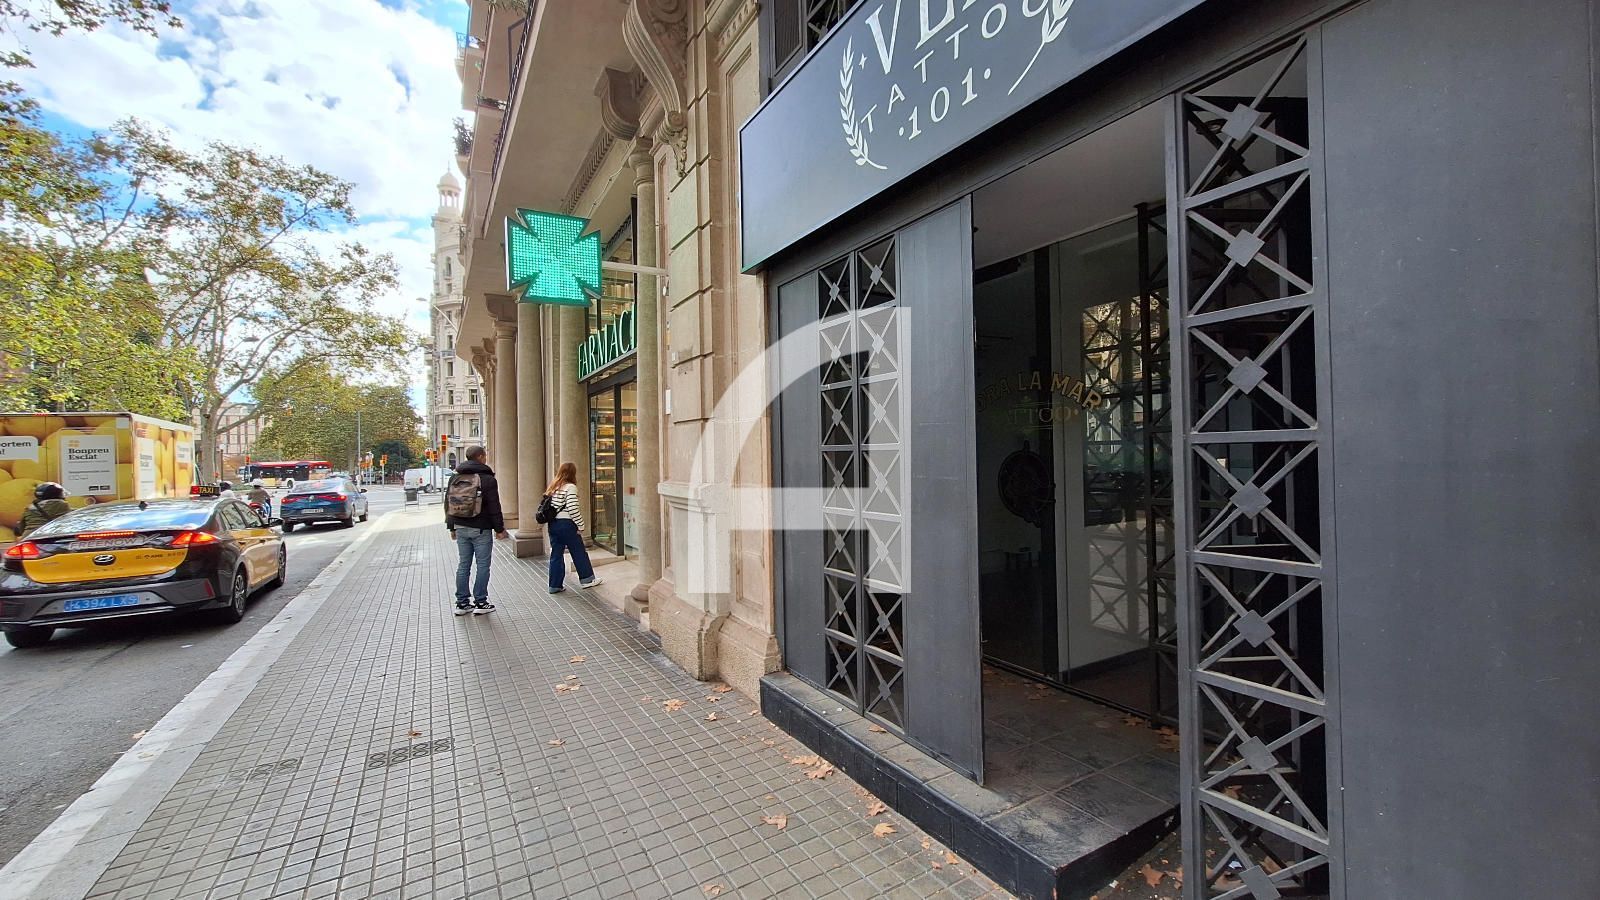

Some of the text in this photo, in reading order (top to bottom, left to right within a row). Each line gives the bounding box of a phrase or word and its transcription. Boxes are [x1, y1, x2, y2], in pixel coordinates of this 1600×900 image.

[578, 302, 636, 379] FARMACI
[1018, 371, 1042, 391] LA
[1050, 372, 1102, 412] MAR
